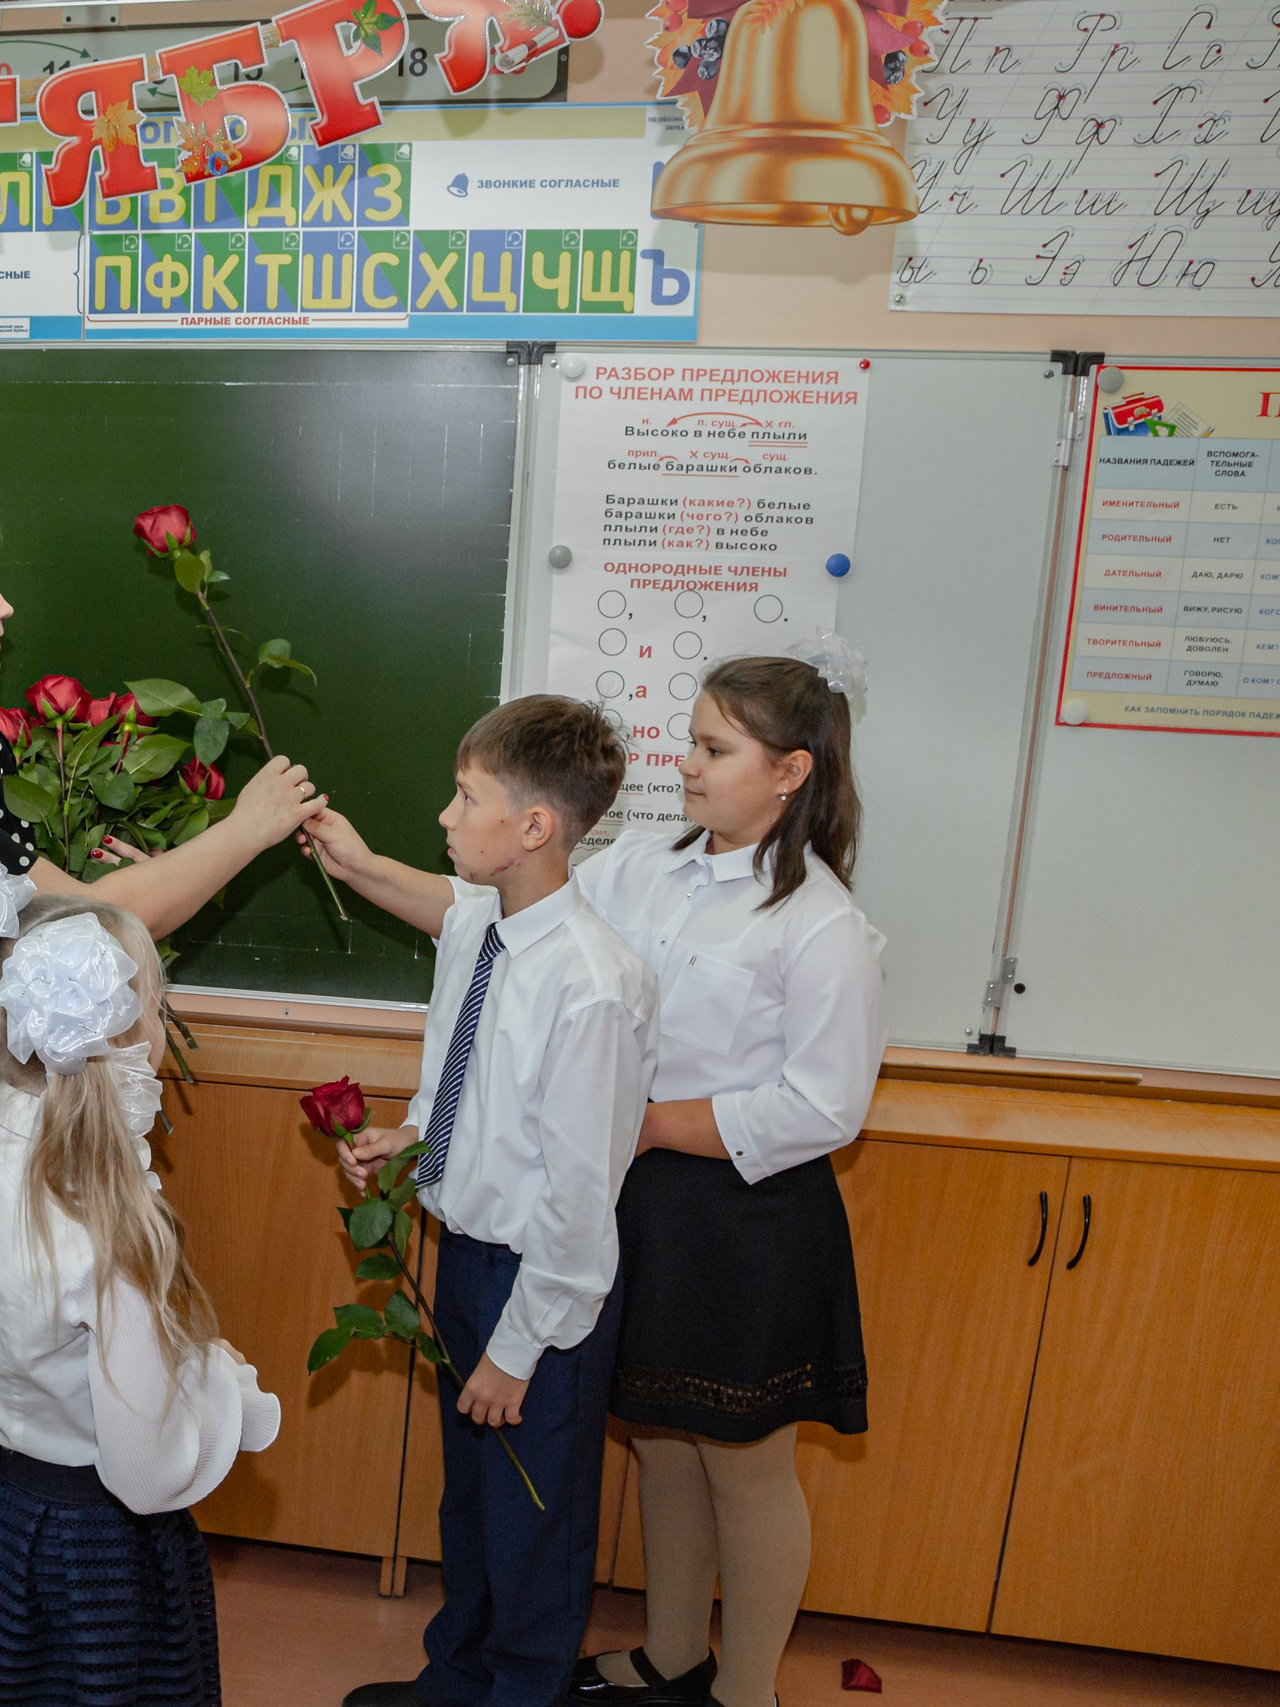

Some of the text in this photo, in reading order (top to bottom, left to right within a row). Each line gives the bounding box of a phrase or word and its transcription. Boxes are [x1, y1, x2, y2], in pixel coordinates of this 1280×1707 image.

[477, 178, 620, 189] ЗВОНКИЕ СОГЛАСНЫЕ
[181, 316, 310, 326] ПАРНЫЕ СОГЛАСНЫЕ
[595, 366, 839, 385] РАЗБОР ПРЕДЛОЖЕНИЯ
[574, 386, 858, 405] ПО ЧЛЕНАМ ПРЕДЛОЖЕНИЯ
[711, 419, 738, 429] сущ.
[624, 426, 808, 441] Высоко в небе плыли
[627, 450, 660, 460] прил.
[703, 450, 731, 461] сущ.
[762, 452, 789, 462] сущ.
[1099, 450, 1259, 467] НАЗВАНИЯ ПАДЕЖЕЙ ВСПОМОГА-
[607, 459, 818, 476] белые барашки облаков.
[1210, 460, 1254, 468] ТЕЛЬНЫЕ
[1214, 470, 1246, 478] СЛОВА
[605, 494, 811, 511] Барашки (какие?) белые
[1102, 500, 1180, 509] ИМЕНИТЕЛЬНЫЙ
[604, 508, 814, 525] барашки (чего?) облаков
[603, 523, 769, 537] плыли (где?) в небе
[602, 537, 778, 551] плыли (как?) высоко
[1101, 534, 1172, 543] РОДИТЕЛЬНЫЙ
[603, 561, 787, 578] ОДНОРОДНЫЕ ЧЛЕНЫ
[1103, 569, 1162, 578] ДАТЕЛЬНЫЙ
[1191, 571, 1214, 579] ДАЮ,
[1216, 572, 1244, 580] ДАРЮ
[630, 578, 759, 593] ПРЕДЛОЖЕНИЯ
[1093, 604, 1163, 614] ВИНИТЕЛЬНЫЙ
[1183, 605, 1210, 614] ВИЖУ,
[1211, 606, 1243, 614] РИСУЮ
[1087, 638, 1162, 648] ТВОРИТЕЛЬНЫЙ
[1186, 645, 1229, 653] ДОВОЛЕН
[1086, 670, 1223, 681] ПРЕДЛОЖНЫЙ ГОВОРЮ,
[1124, 705, 1280, 720] КАК ЗАПОМНИТЬ ПОРЯДОК ПАДЕЖ
[647, 782, 681, 794] (кто?
[627, 809, 654, 821] (что
[656, 812, 692, 822] дела
